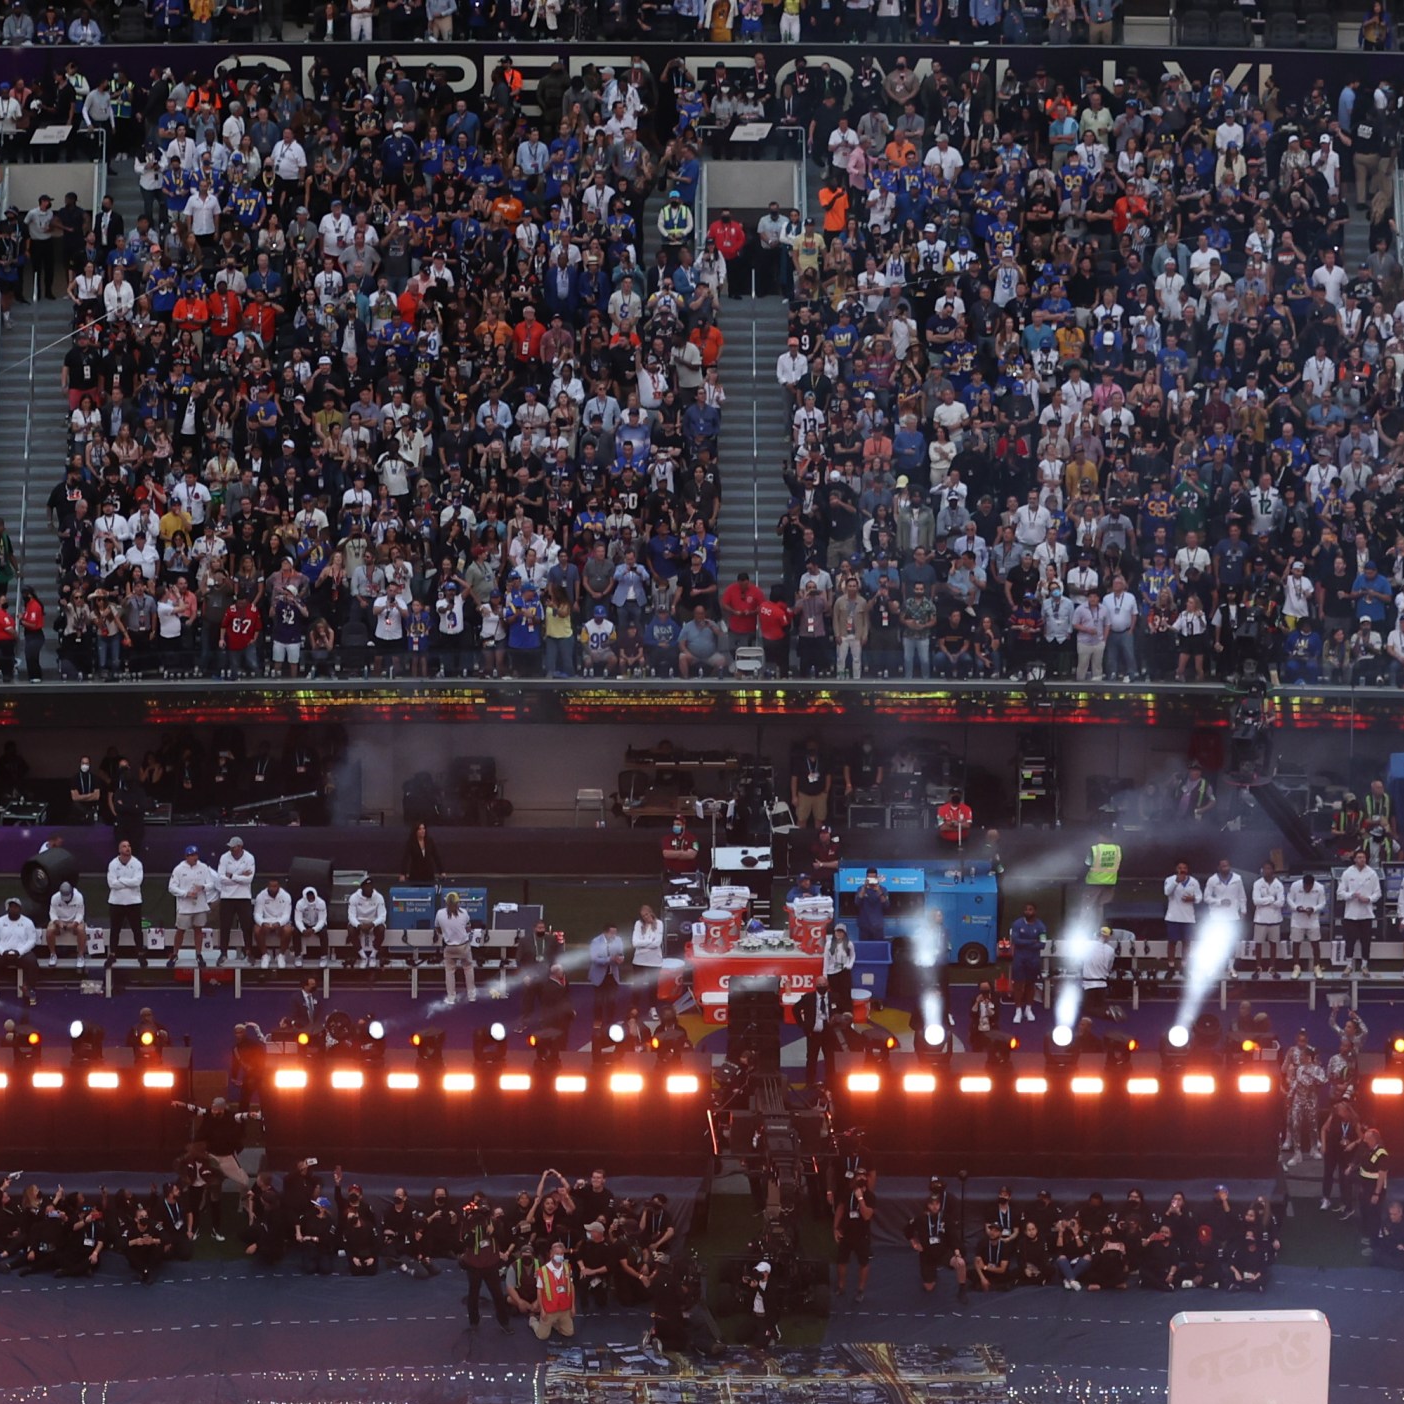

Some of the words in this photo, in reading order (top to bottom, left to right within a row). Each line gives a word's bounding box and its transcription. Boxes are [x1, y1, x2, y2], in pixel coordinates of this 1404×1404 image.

[1064, 175, 1083, 191] 99
[237, 199, 257, 215] 77
[801, 335, 810, 350] 9
[1259, 499, 1272, 514] 12
[760, 606, 772, 616] CSC
[232, 617, 252, 634] 87
[710, 926, 721, 938] G
[810, 926, 822, 939] G
[718, 975, 814, 988] GADE
[713, 1008, 727, 1021] G
[1187, 1327, 1311, 1385] Tam's
